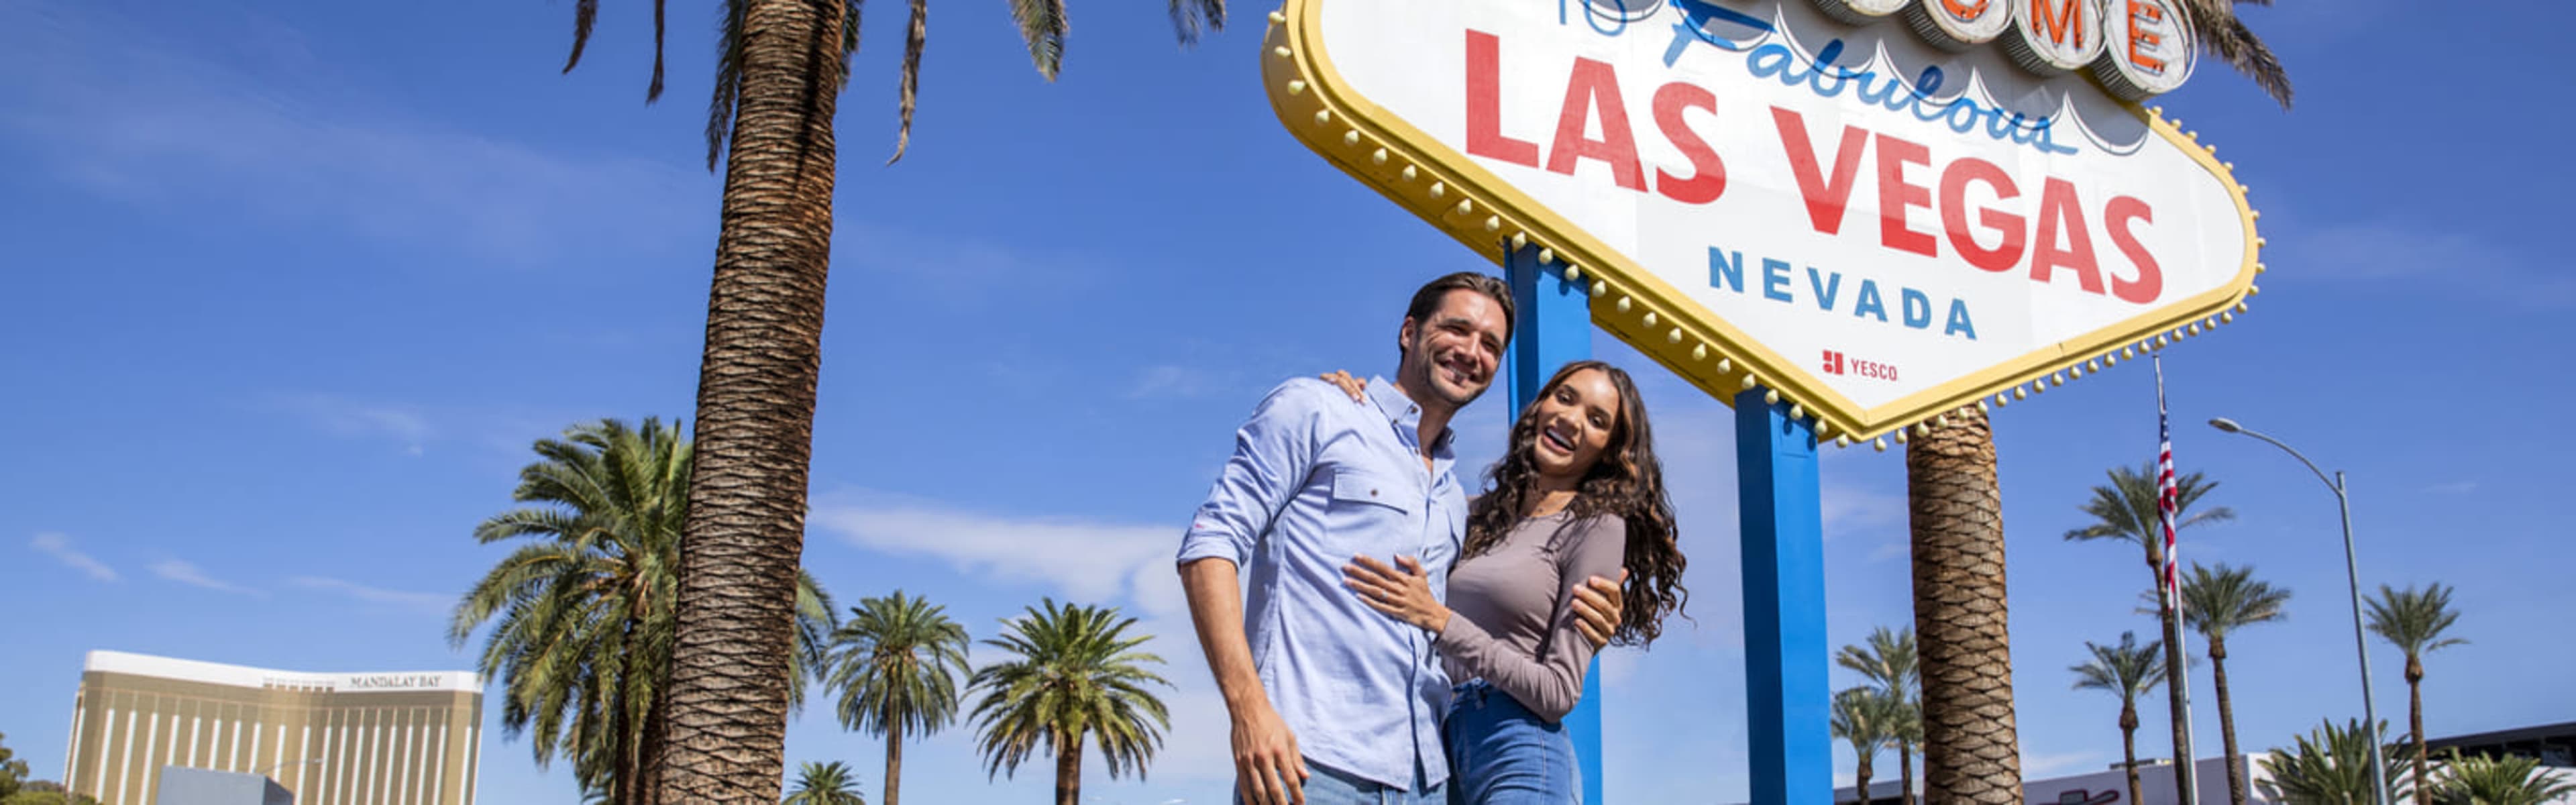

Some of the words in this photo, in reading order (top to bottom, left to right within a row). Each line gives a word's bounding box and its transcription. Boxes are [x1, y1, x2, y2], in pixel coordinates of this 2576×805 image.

[1465, 28, 1727, 205] LAS
[1766, 105, 2163, 305] VEGAS
[1708, 246, 1978, 341] NEVADA
[1850, 358, 1898, 382] YESCO
[350, 676, 416, 688] MANDALAY
[419, 675, 442, 688] BAY
